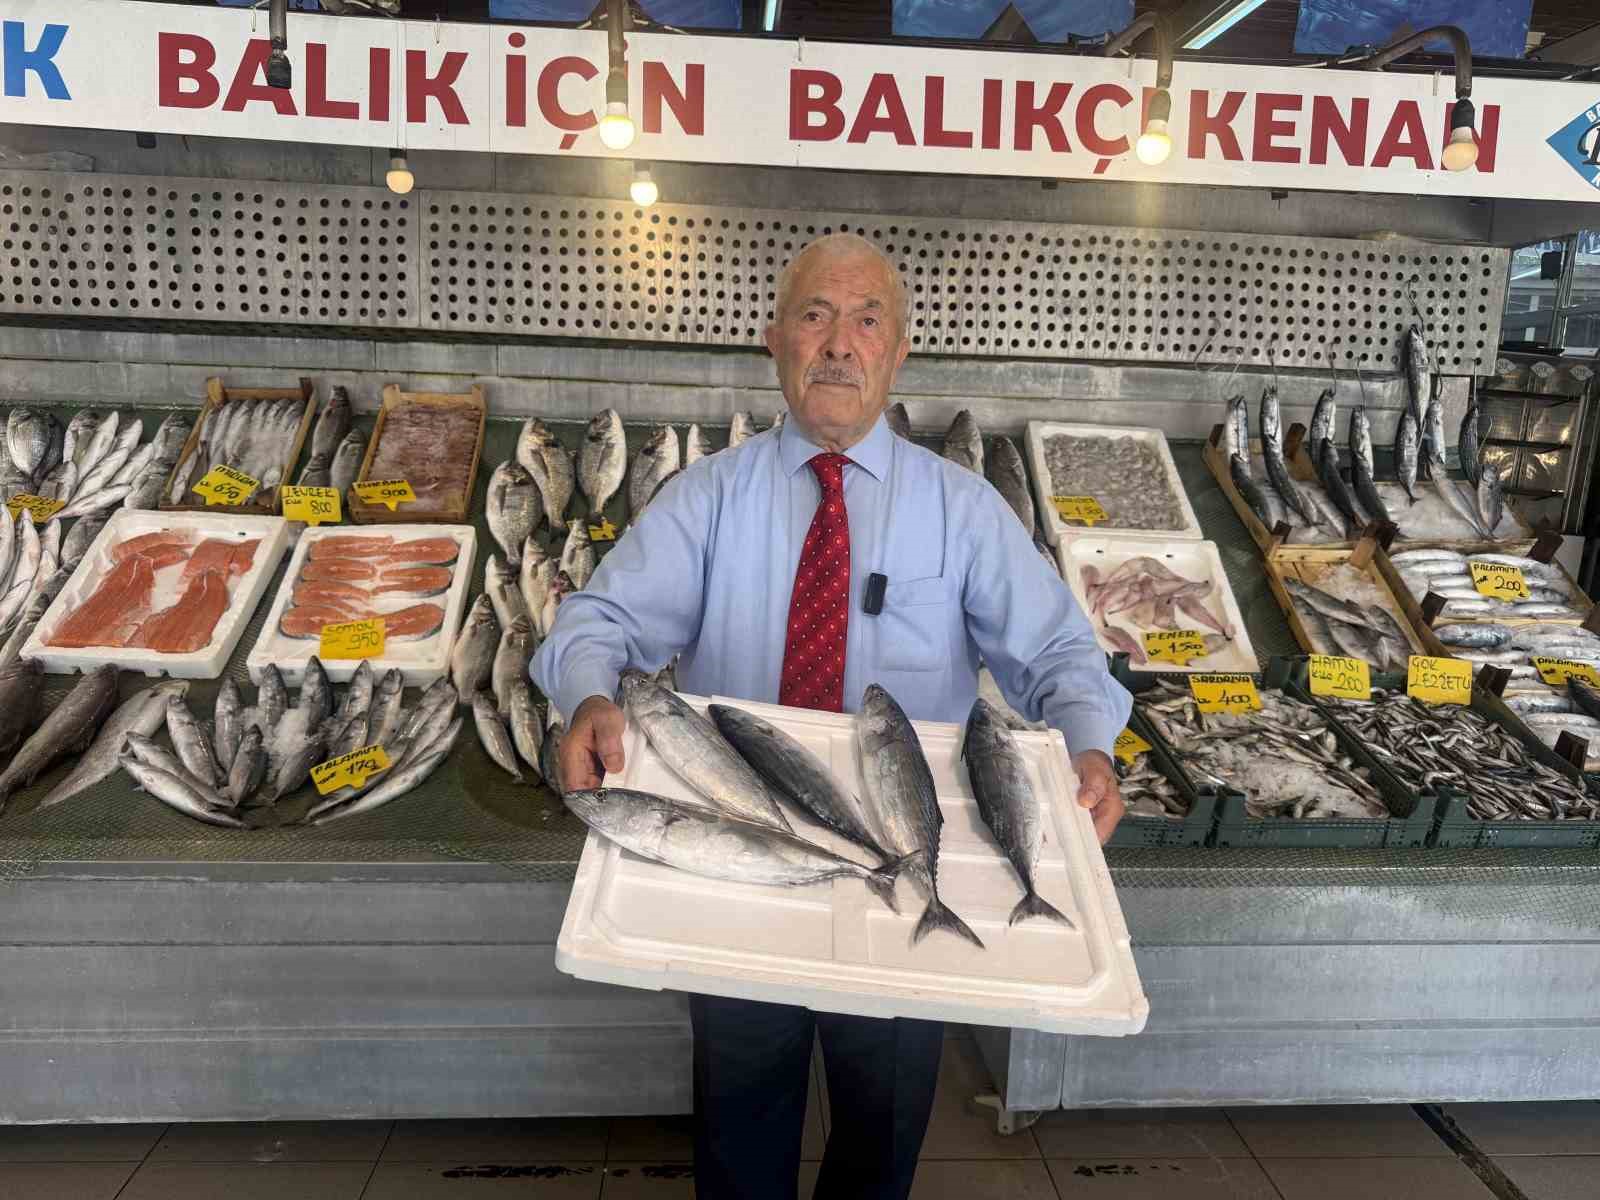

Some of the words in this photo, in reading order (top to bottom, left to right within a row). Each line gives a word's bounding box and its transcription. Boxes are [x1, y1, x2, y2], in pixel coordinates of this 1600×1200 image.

[4, 21, 72, 100] K
[159, 33, 469, 125] BALIK
[507, 33, 705, 150] İÇN
[1188, 91, 1501, 173] KENAN
[214, 483, 240, 499] 650
[285, 487, 336, 497] LEVREK
[381, 489, 407, 499] 900
[310, 500, 333, 515] 800
[1473, 563, 1518, 573] PALAMUT
[1494, 576, 1521, 592] 200
[346, 630, 379, 649] 950
[1145, 630, 1198, 641] FENER
[1331, 672, 1364, 693] 200
[1218, 689, 1251, 705] 400
[314, 745, 378, 776] PALAMUT
